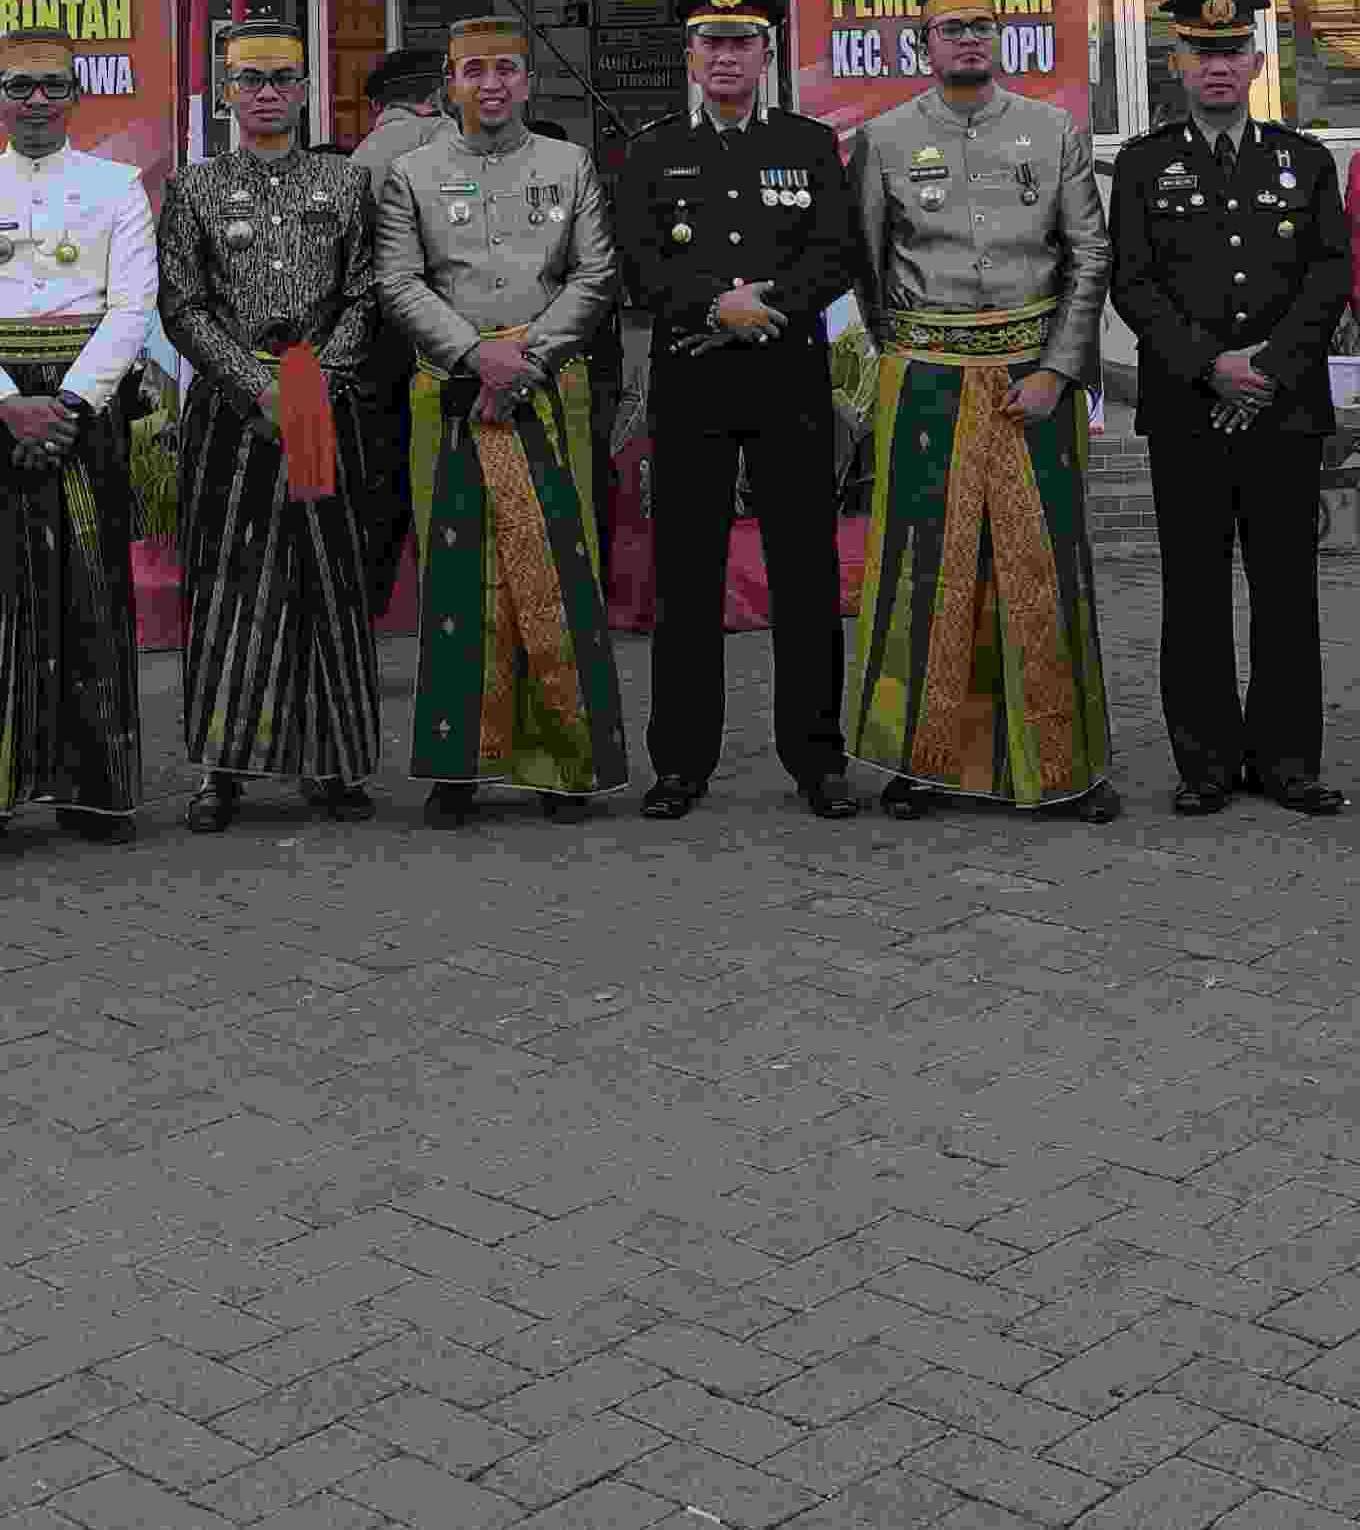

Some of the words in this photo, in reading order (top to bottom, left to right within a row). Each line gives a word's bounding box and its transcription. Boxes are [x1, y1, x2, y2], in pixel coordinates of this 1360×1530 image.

[75, 54, 136, 95] OWA
[832, 29, 889, 78] KEC.
[1000, 24, 1056, 74] OPU
